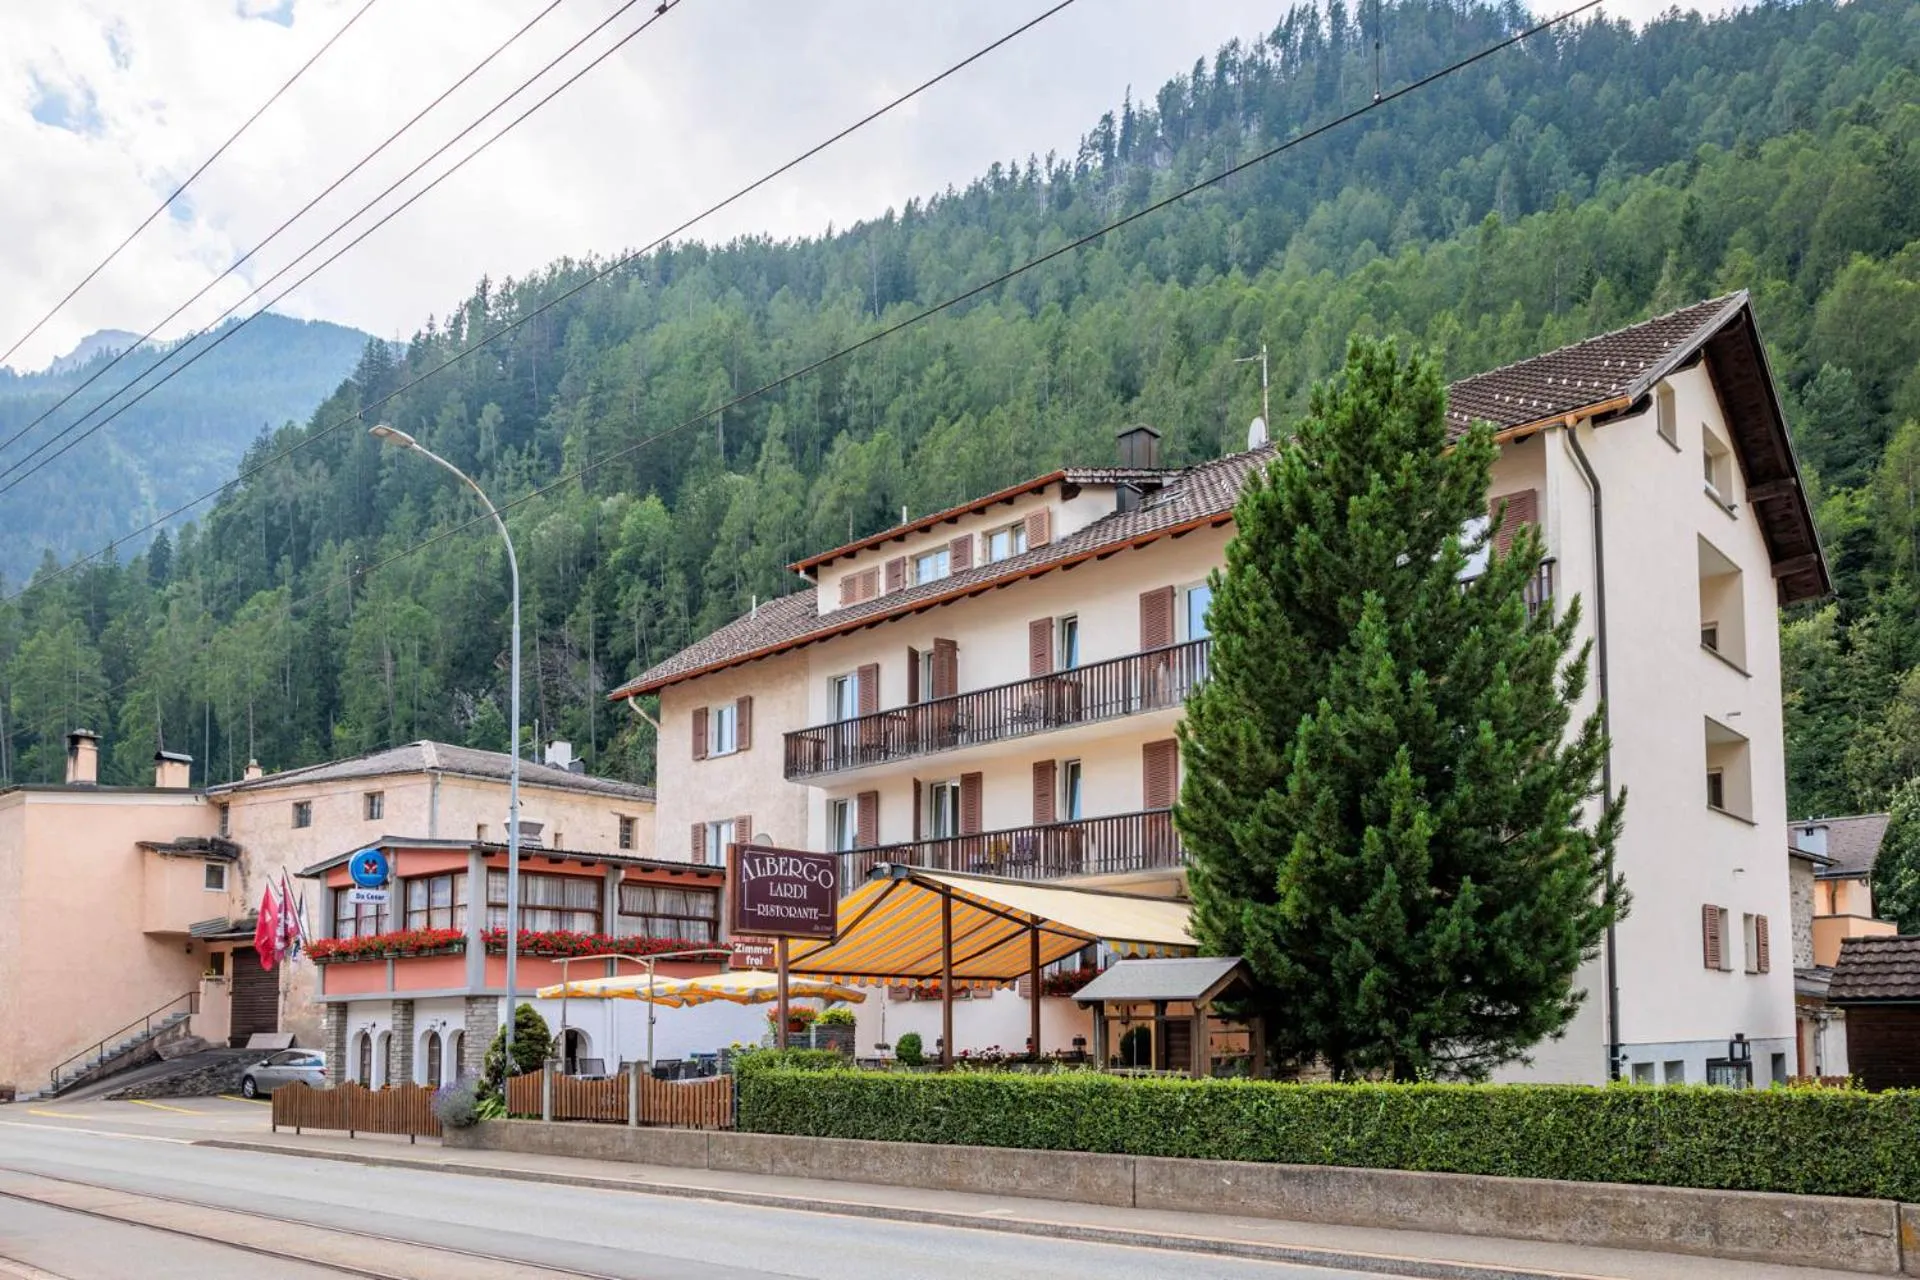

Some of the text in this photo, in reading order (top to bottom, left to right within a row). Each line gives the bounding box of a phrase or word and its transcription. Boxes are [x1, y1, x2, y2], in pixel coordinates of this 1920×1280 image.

[742, 857, 834, 889] ALBERGO
[769, 882, 807, 899] LARDI
[757, 904, 819, 920] RISTORANTE
[734, 942, 773, 955] Zimmer
[746, 954, 763, 966] frei
